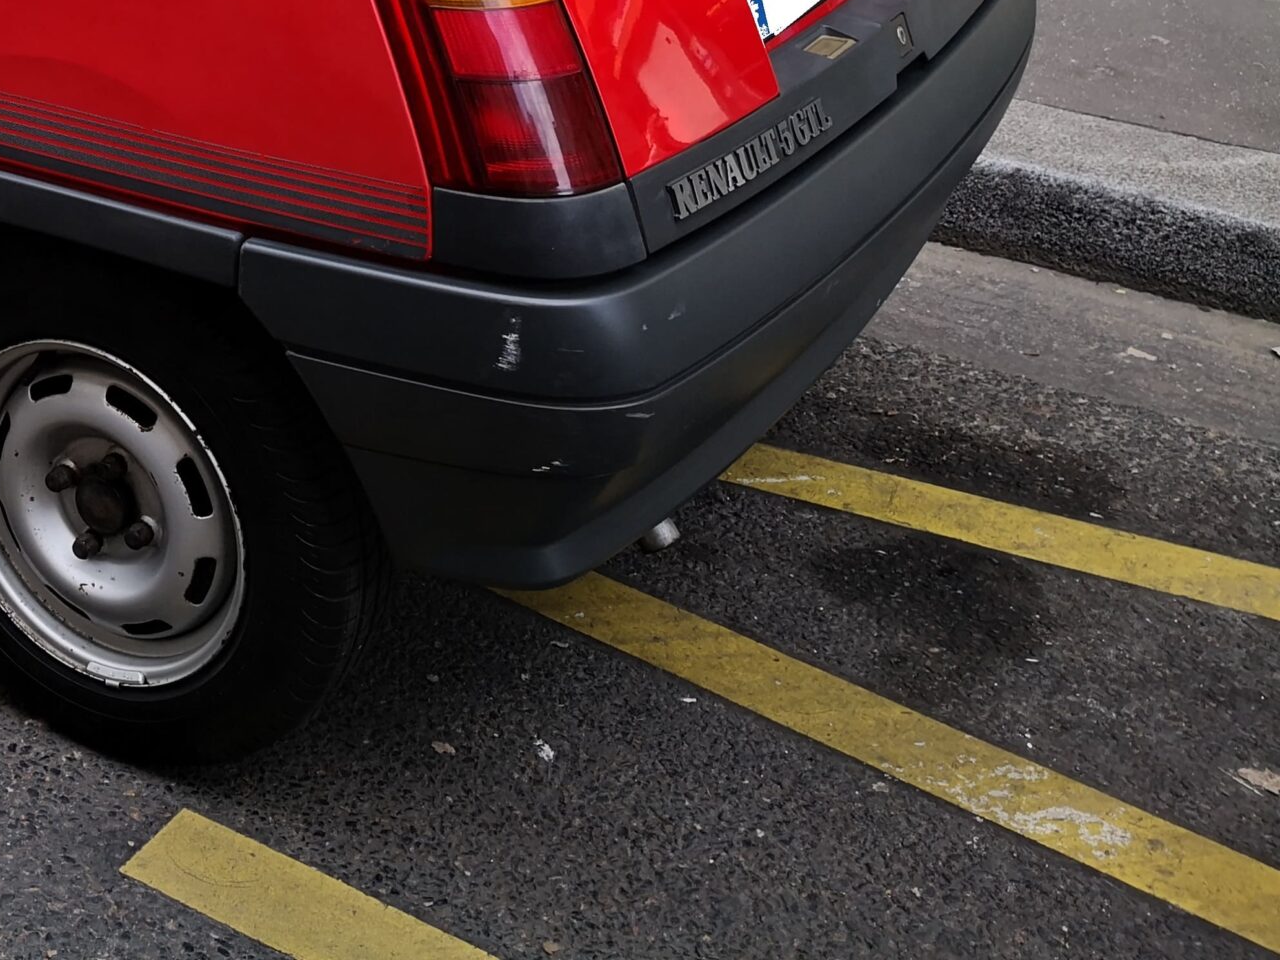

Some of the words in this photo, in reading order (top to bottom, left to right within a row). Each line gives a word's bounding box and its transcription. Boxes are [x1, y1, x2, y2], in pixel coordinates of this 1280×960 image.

[671, 128, 780, 219] RENAULT
[780, 120, 795, 156] 5
[790, 98, 833, 146] GTL
